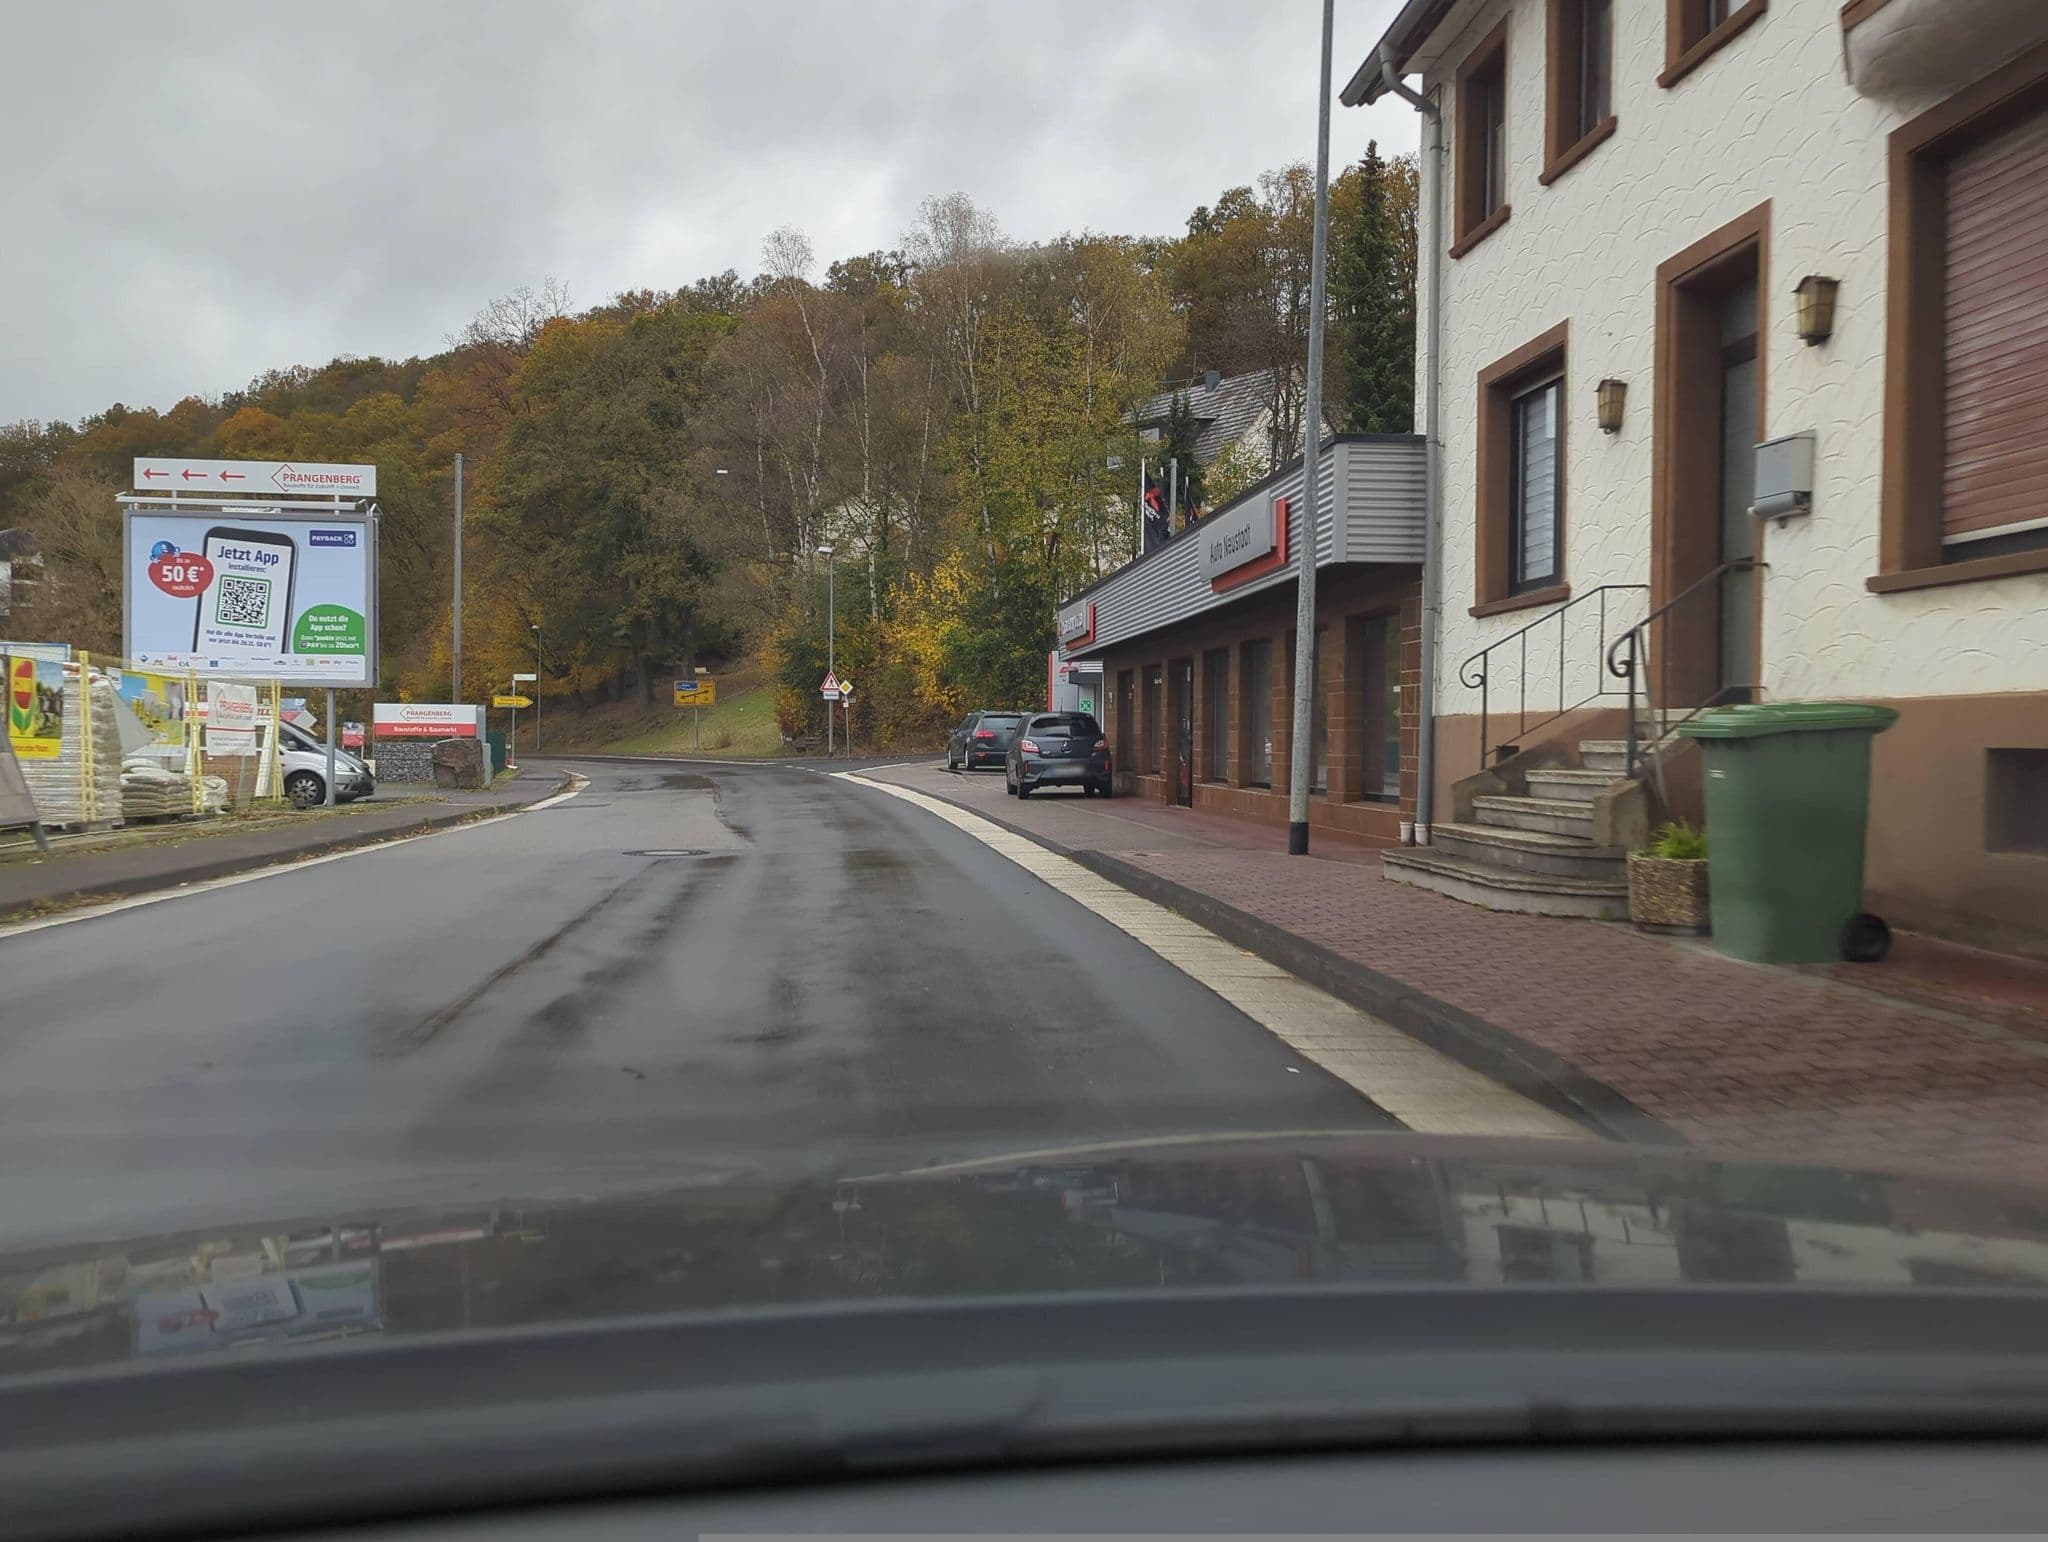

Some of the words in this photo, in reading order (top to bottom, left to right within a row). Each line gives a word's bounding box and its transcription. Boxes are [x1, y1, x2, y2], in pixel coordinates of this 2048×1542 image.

[283, 473, 360, 484] PRANGENBERG
[311, 534, 343, 543] PAYBACK
[217, 545, 252, 562] Jetzt
[254, 550, 279, 566] App
[162, 565, 184, 583] 50
